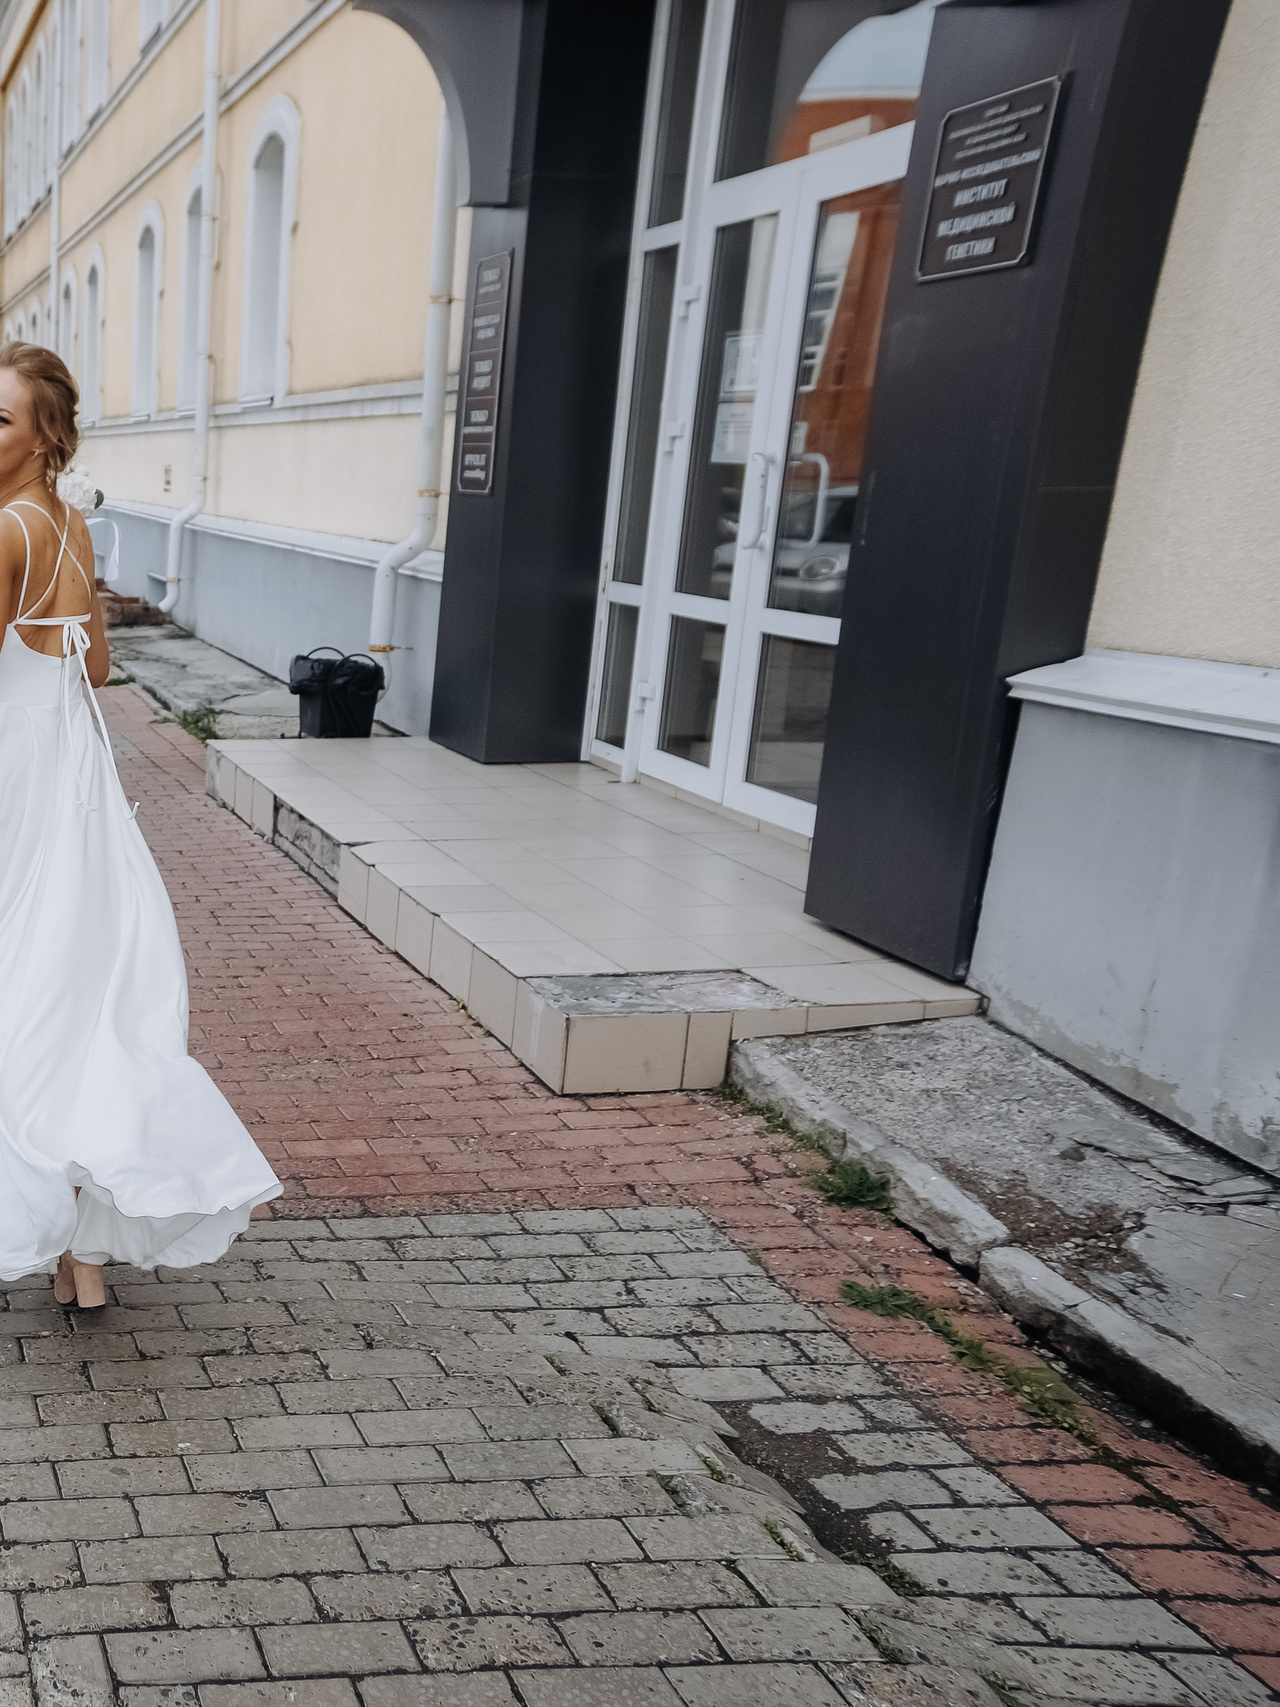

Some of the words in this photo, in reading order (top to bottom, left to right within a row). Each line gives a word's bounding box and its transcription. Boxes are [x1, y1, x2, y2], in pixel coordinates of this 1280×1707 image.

[953, 178, 1009, 208] ИНСТИТУТ
[937, 202, 1016, 238] МЕДИЦИНСКОЙ
[945, 237, 996, 261] ГЕНЕТИКИ
